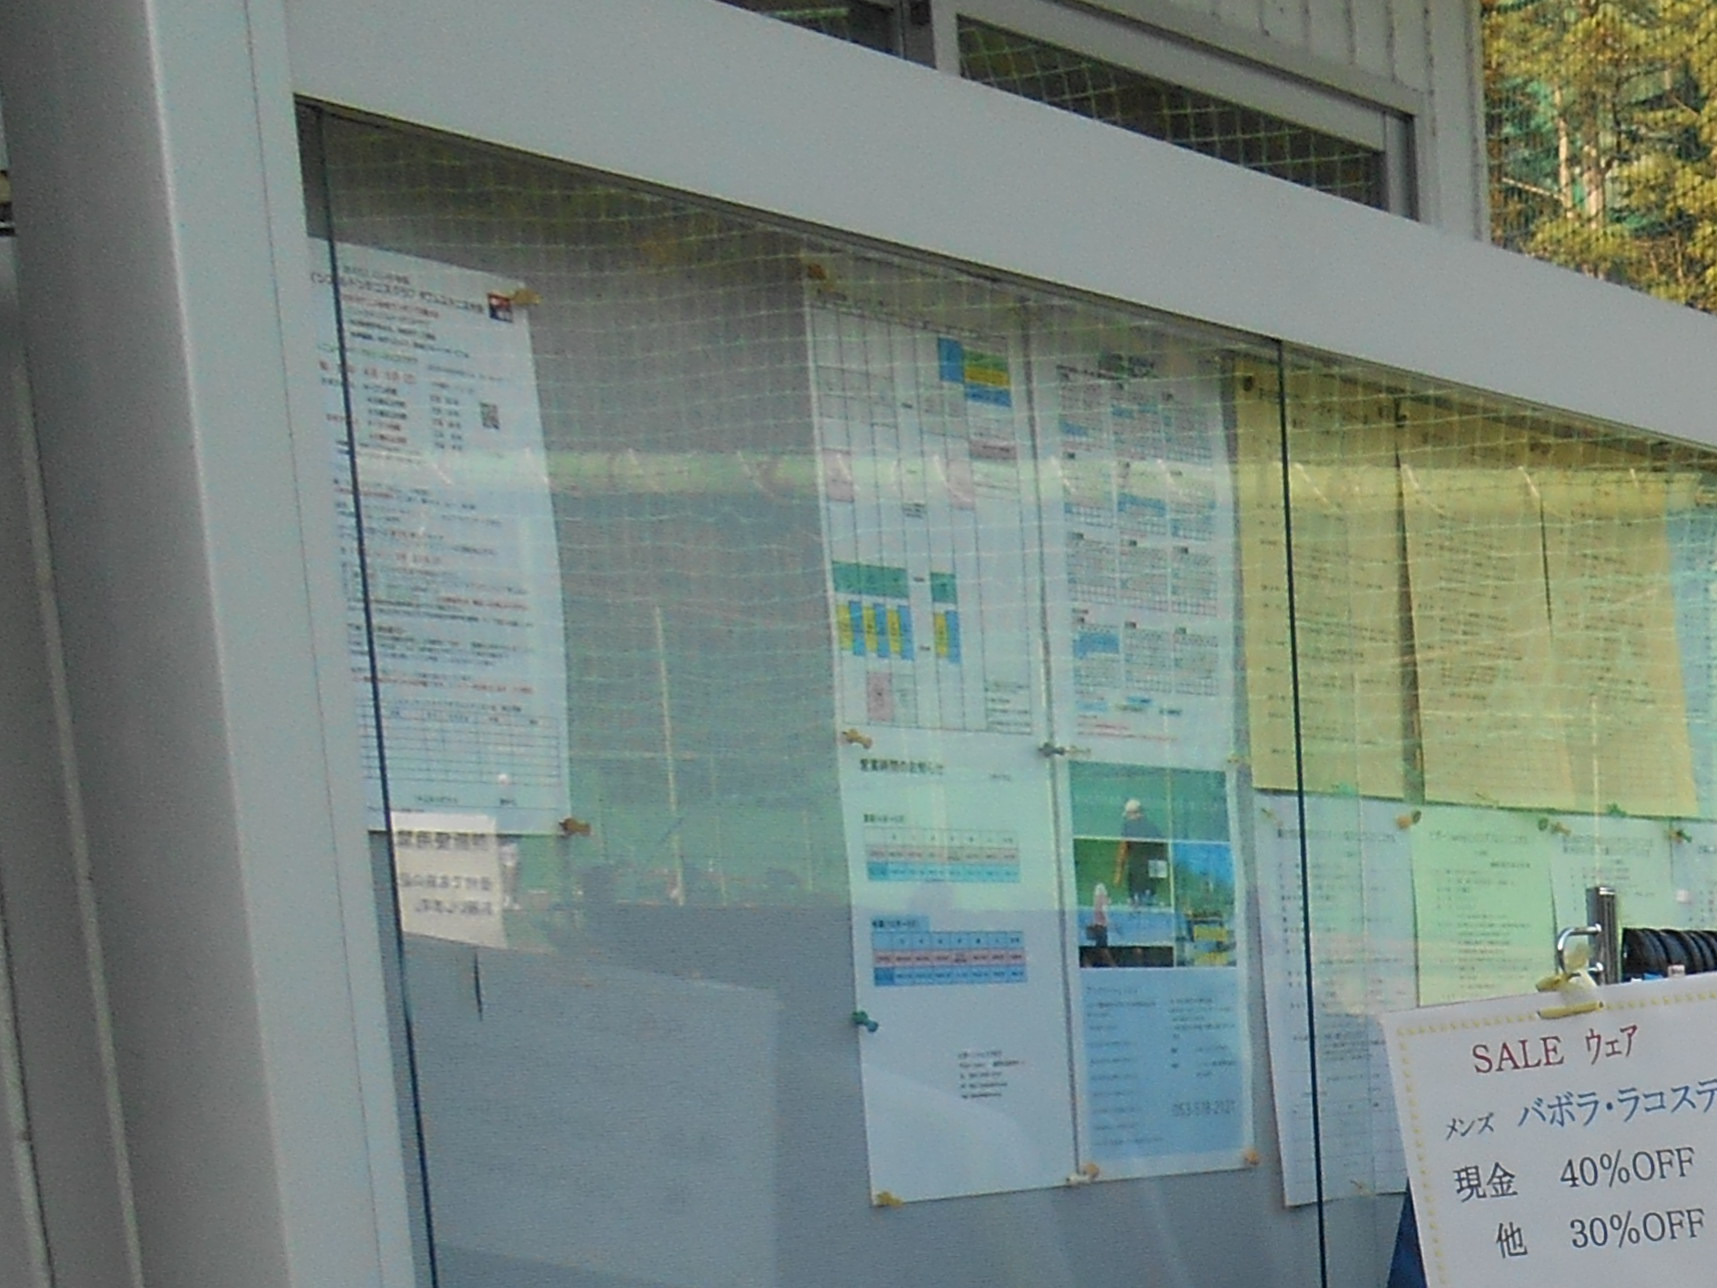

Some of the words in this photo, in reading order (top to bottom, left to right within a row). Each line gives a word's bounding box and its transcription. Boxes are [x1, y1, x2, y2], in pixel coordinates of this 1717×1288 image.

[1471, 1036, 1565, 1074] SALE
[1445, 1112, 1495, 1140] メンズ
[1453, 1161, 1518, 1202] 現金
[1560, 1147, 1696, 1188] 40%OFF
[1496, 1222, 1528, 1260] 他
[1568, 1208, 1706, 1249] 30%OFF
